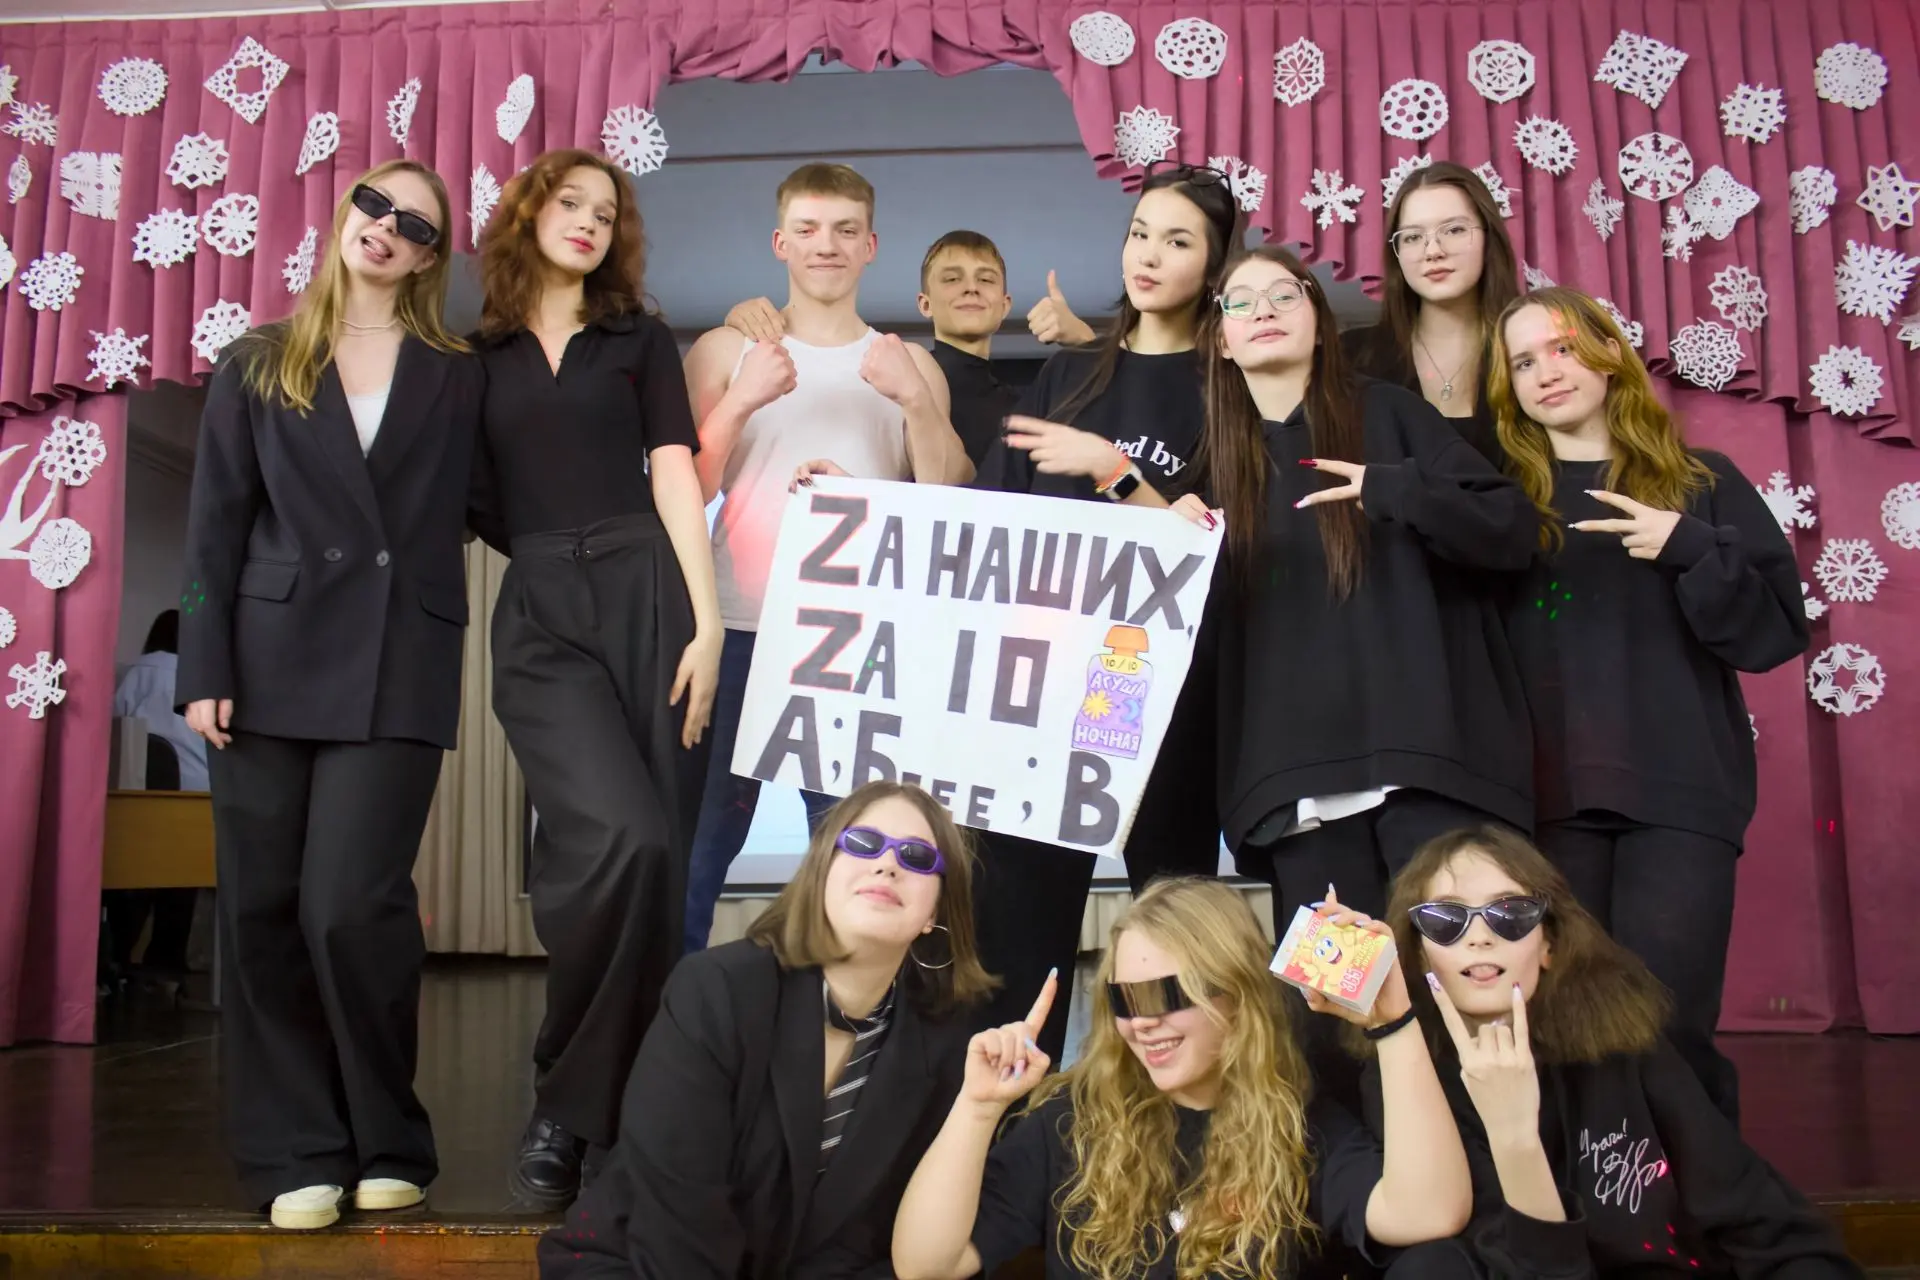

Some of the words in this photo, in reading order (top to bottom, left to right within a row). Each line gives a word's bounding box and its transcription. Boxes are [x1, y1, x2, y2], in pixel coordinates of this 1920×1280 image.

[1149, 441, 1187, 476] by
[926, 519, 1206, 639] НАШИХ,
[1090, 670, 1148, 698] АГУША
[1073, 723, 1141, 753] НОЧНАЯ
